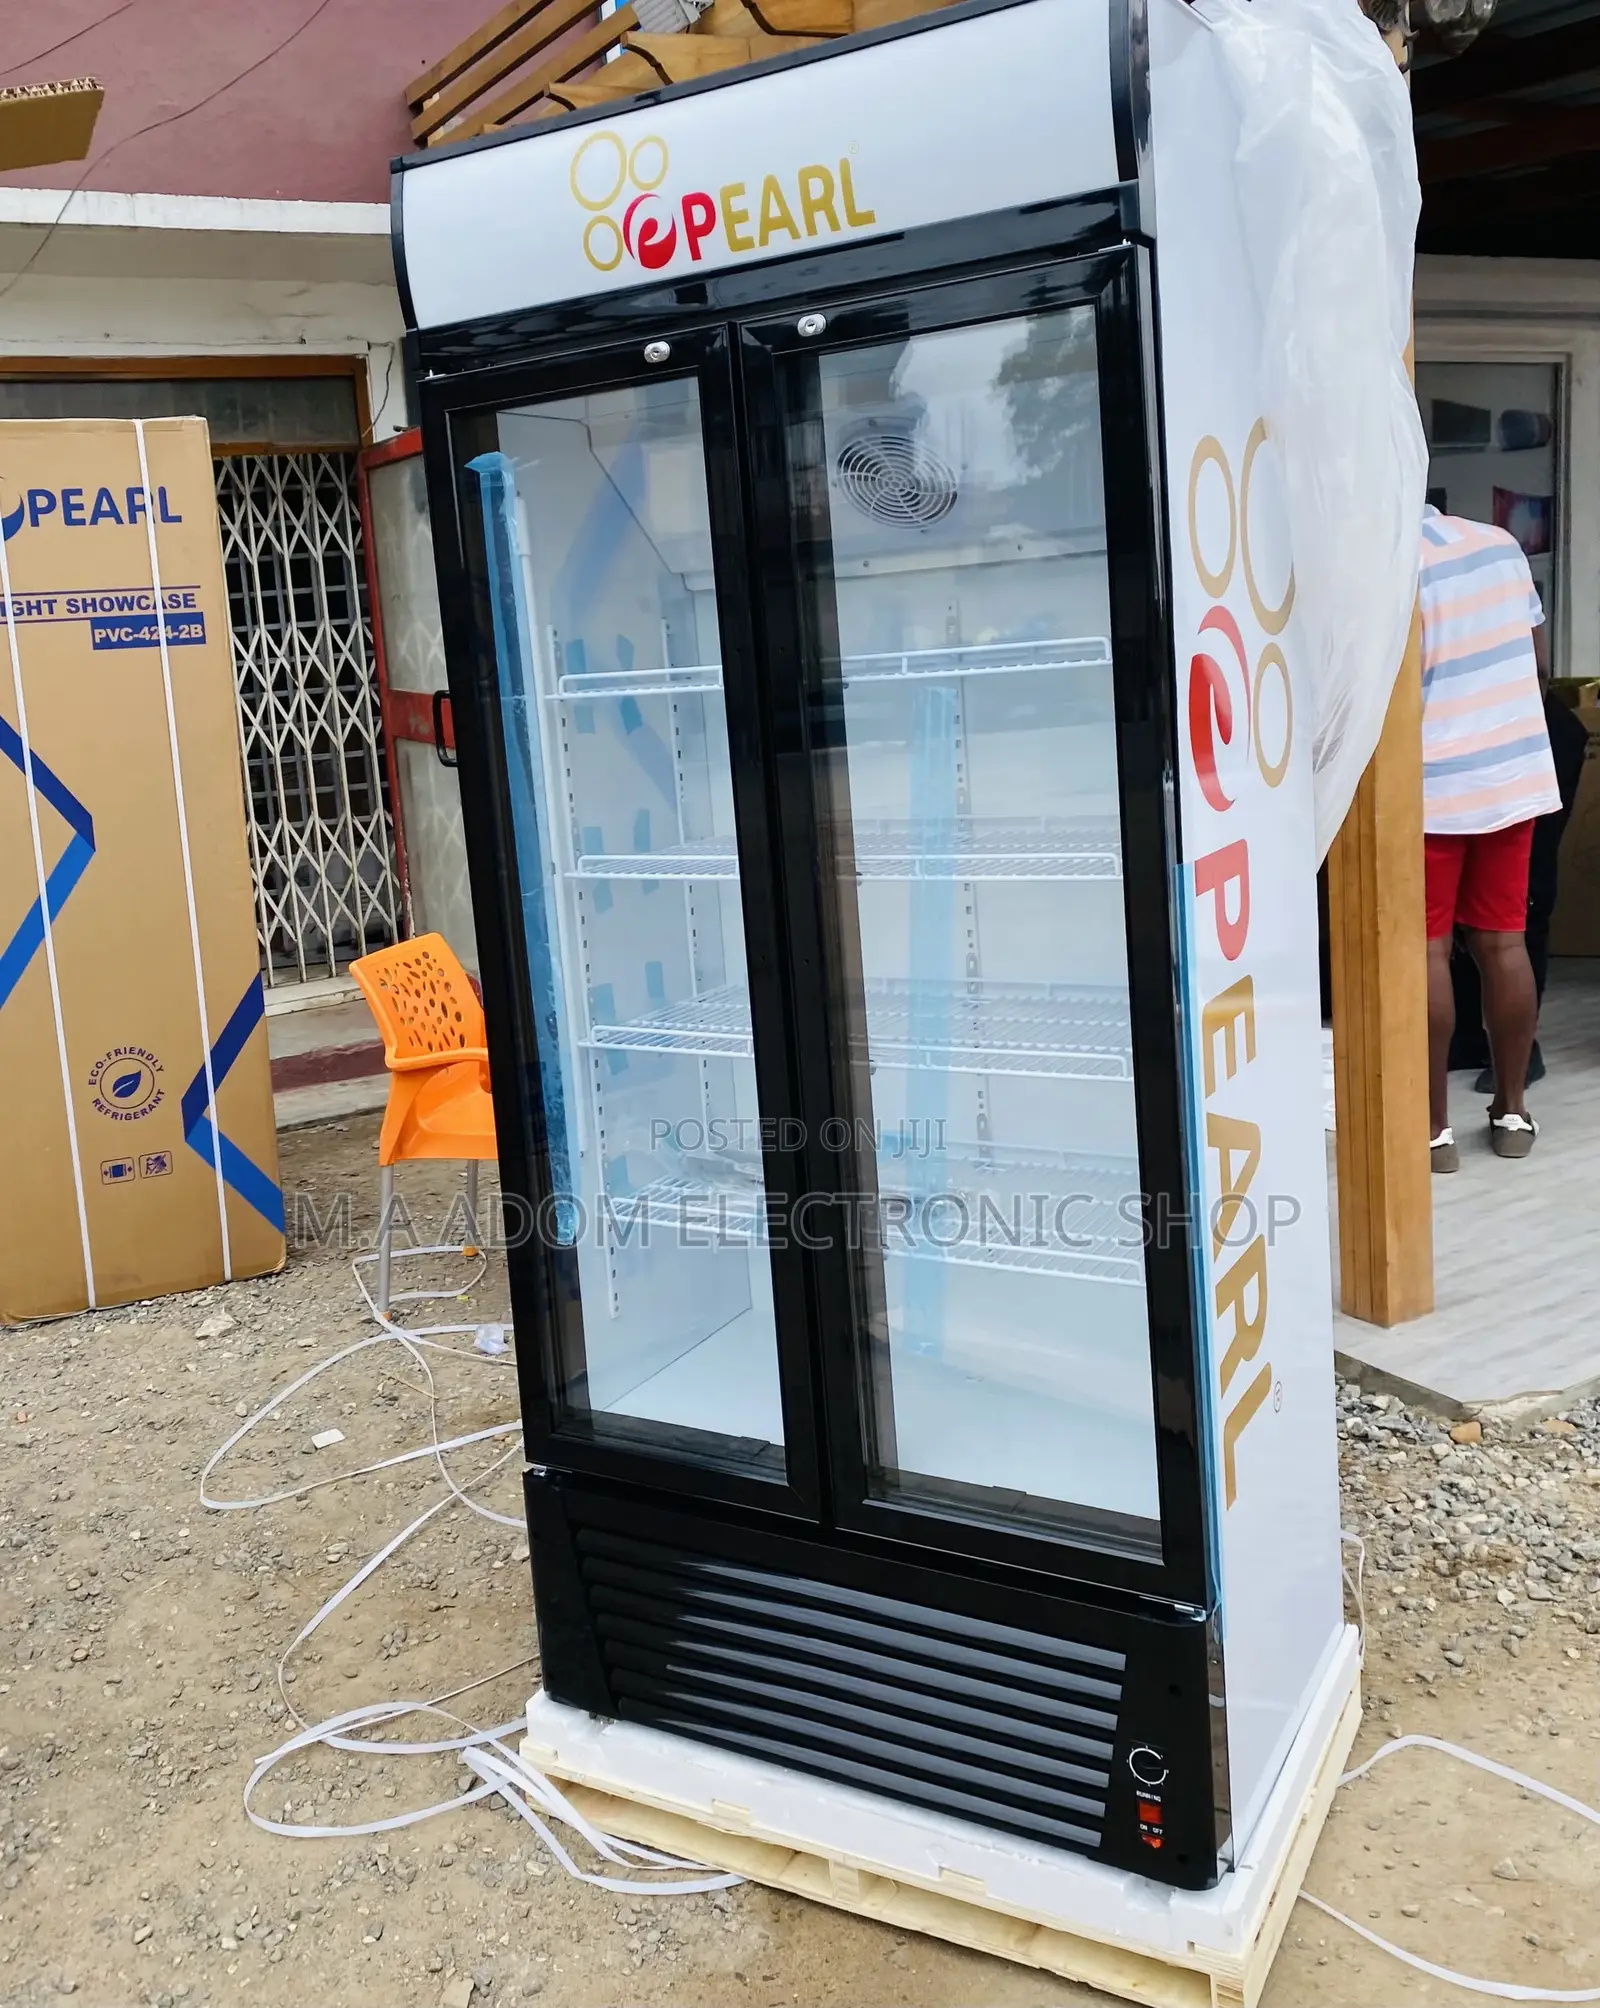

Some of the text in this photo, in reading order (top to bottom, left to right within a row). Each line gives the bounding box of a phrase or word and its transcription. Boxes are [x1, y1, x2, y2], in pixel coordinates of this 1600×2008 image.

[681, 157, 876, 262] PEARL
[27, 486, 183, 528] PEARL
[94, 624, 204, 643] PVC-424-2B
[88, 1046, 165, 1086] ECO-FRIENDLY
[92, 1088, 166, 1121] REFRIGERANT
[1195, 838, 1273, 1512] PEARL
